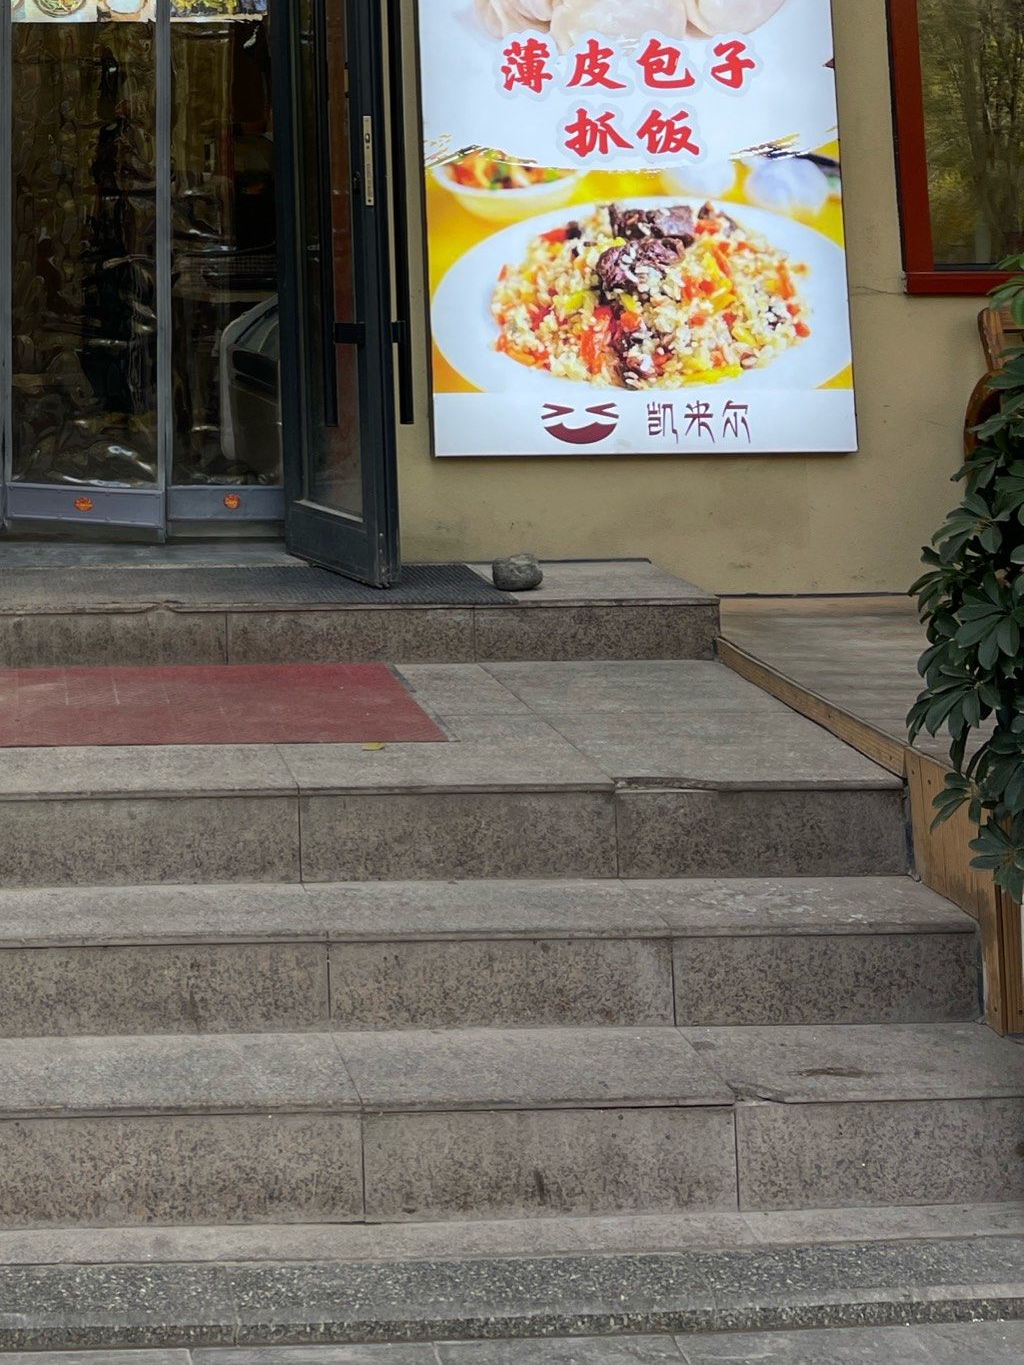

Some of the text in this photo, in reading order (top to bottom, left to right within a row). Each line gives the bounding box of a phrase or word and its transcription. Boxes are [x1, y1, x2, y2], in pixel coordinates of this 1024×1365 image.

[500, 37, 756, 94] 薄皮包子
[564, 107, 700, 157] 抓饭
[646, 399, 752, 445] 凯米尔
